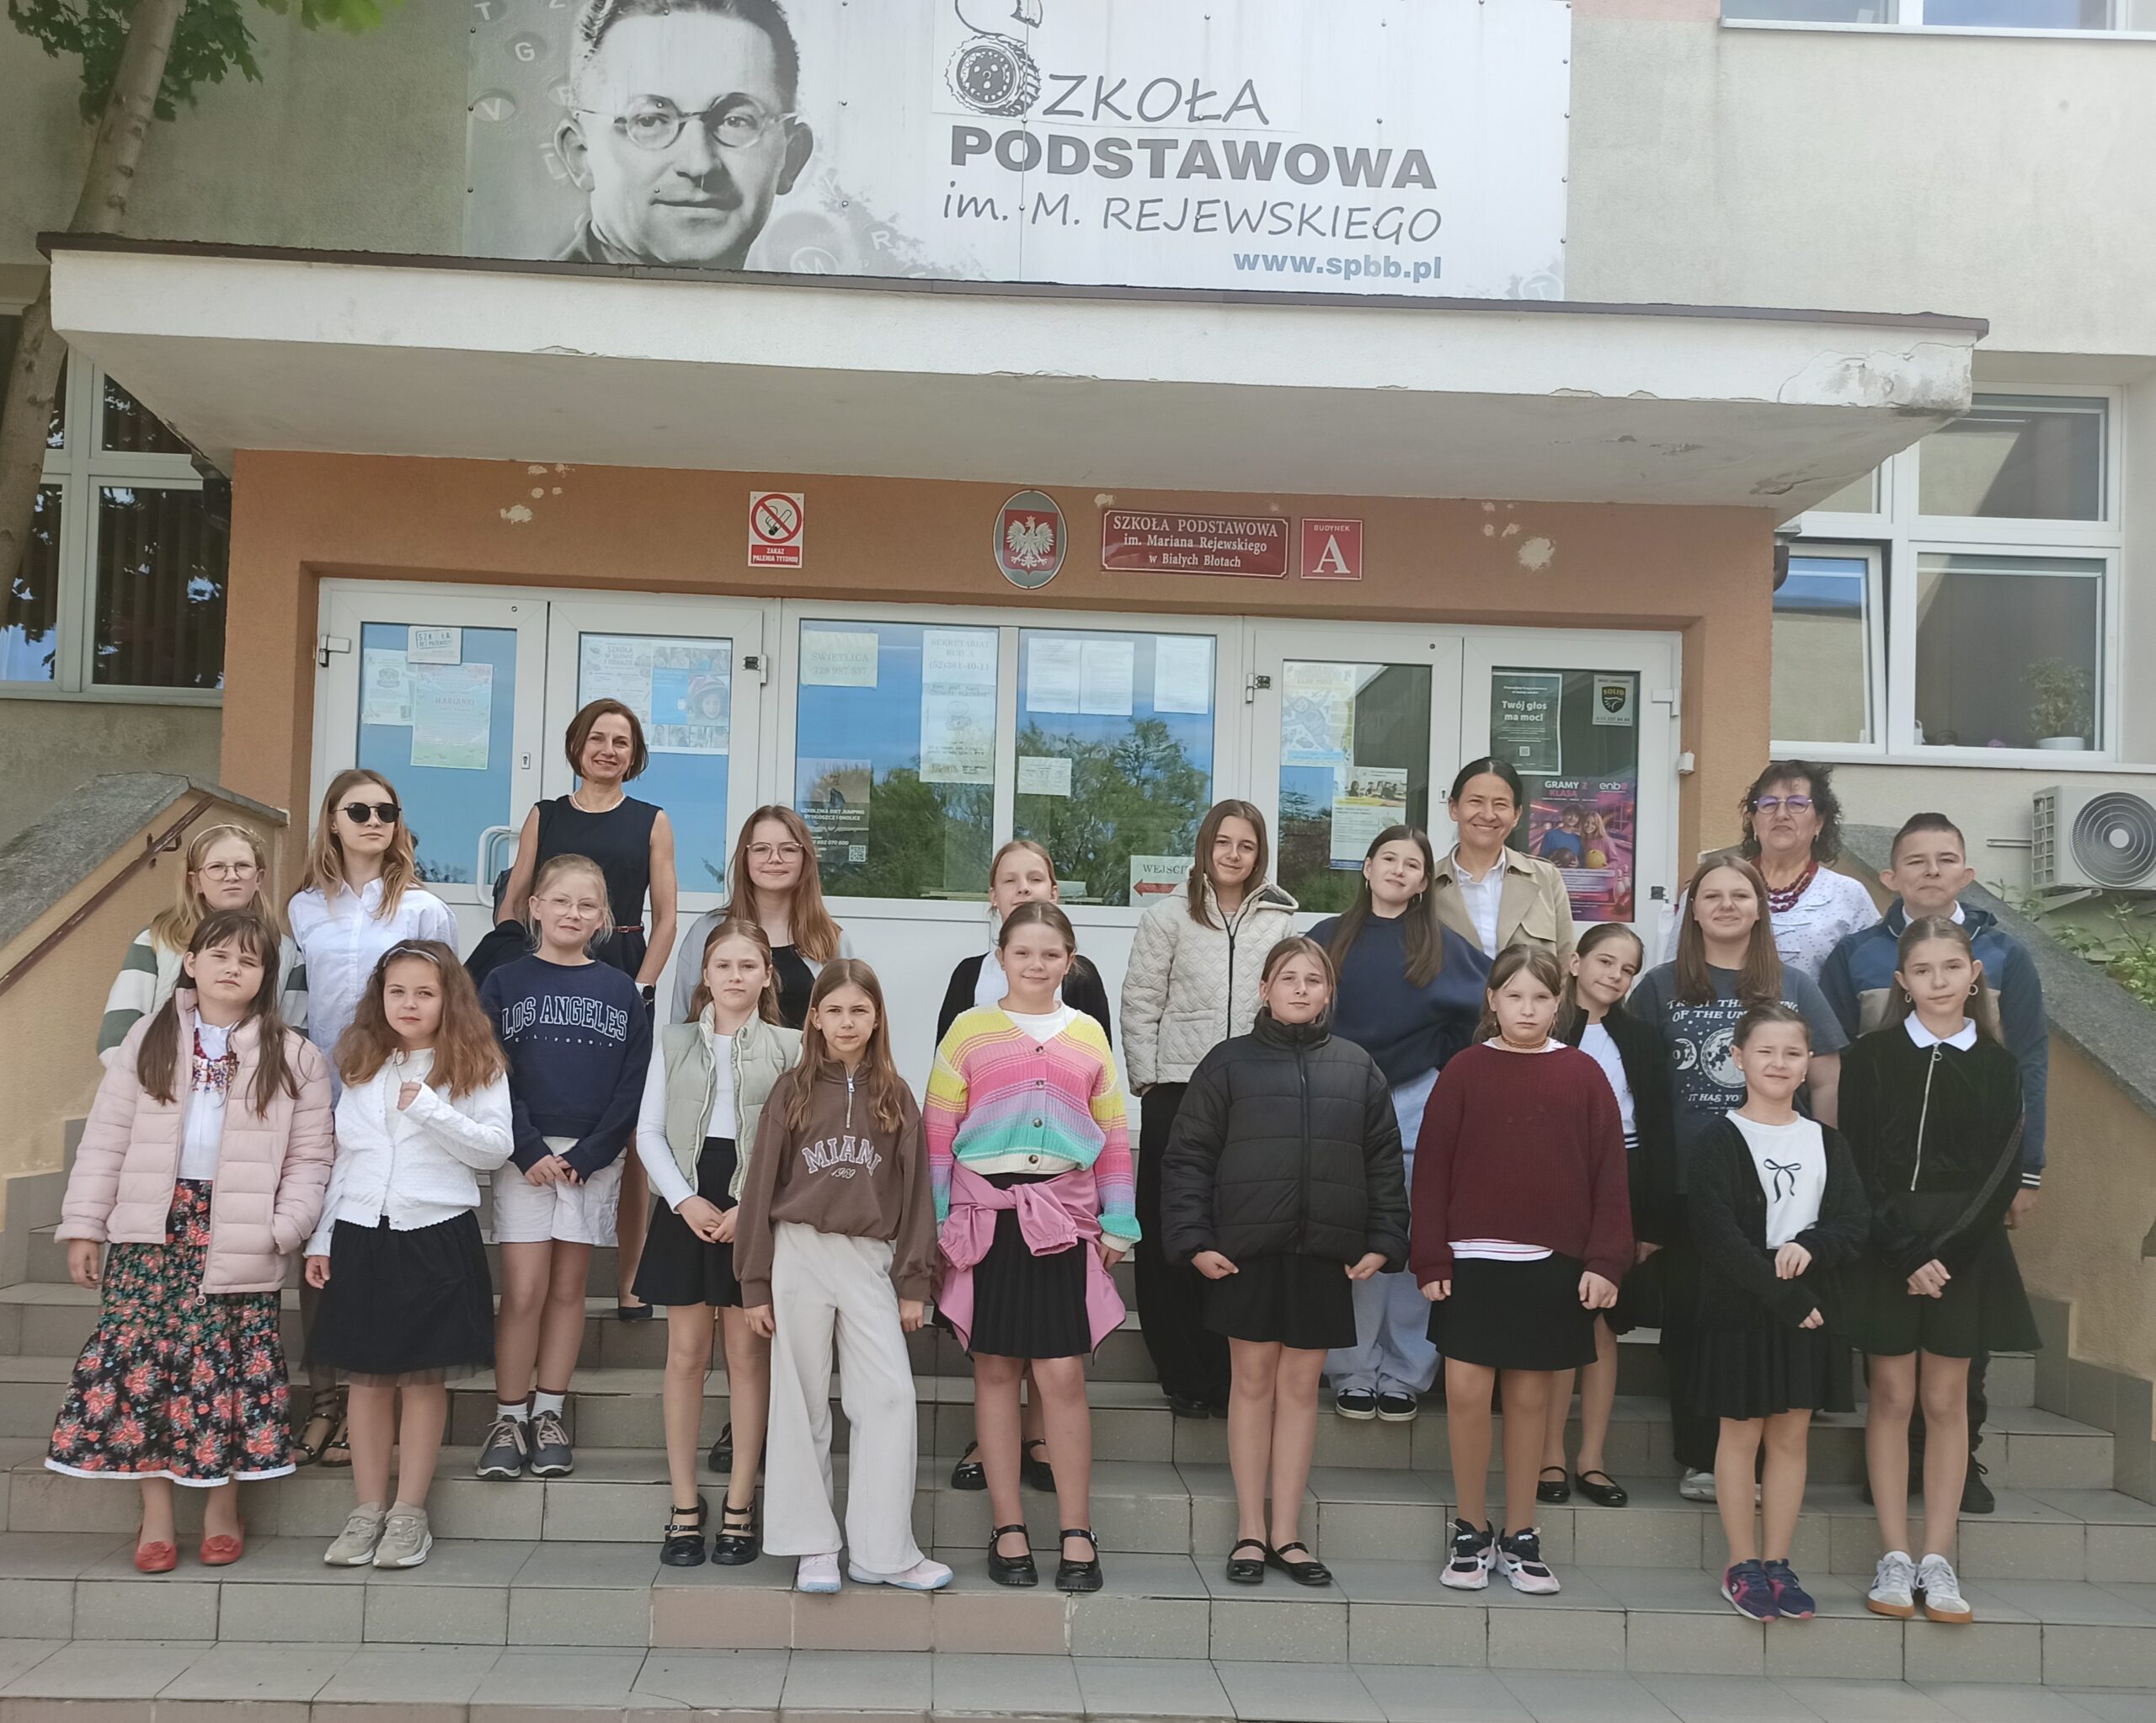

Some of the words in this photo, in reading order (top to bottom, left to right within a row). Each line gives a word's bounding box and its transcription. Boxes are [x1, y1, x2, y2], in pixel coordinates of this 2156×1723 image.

[474, 2, 492, 21] T
[515, 41, 536, 61] G
[480, 97, 501, 122] V
[950, 124, 1438, 190] PODSTAWOWA
[943, 180, 1009, 221] im.
[1031, 191, 1081, 227] M.
[1102, 196, 1443, 246] REJEWSKIEGO
[870, 229, 894, 251] R
[1232, 252, 1443, 284] www.spbb.pl
[1113, 515, 1170, 532] SZKOŁA
[1177, 519, 1278, 537] PODSTAWOWA
[1313, 524, 1351, 532] BUDYNEK
[1123, 532, 1142, 547] im.
[1146, 534, 1194, 548] Mariana
[1199, 536, 1267, 556] Rejewskiego
[1311, 533, 1351, 574] A
[1149, 555, 1158, 564] w
[1162, 552, 1198, 567] Białych
[1203, 554, 1241, 568] Błotach
[930, 638, 990, 648] SEKRETARIAT
[435, 696, 475, 707] MARIANKI
[1502, 700, 1525, 712] Twój
[1544, 780, 1579, 790] GRAMY
[502, 996, 536, 1042] LOS
[540, 995, 628, 1043] ANGELES
[1672, 1010, 1689, 1022] OF
[1692, 1011, 1723, 1019] THE
[1699, 1093, 1722, 1103] HAS
